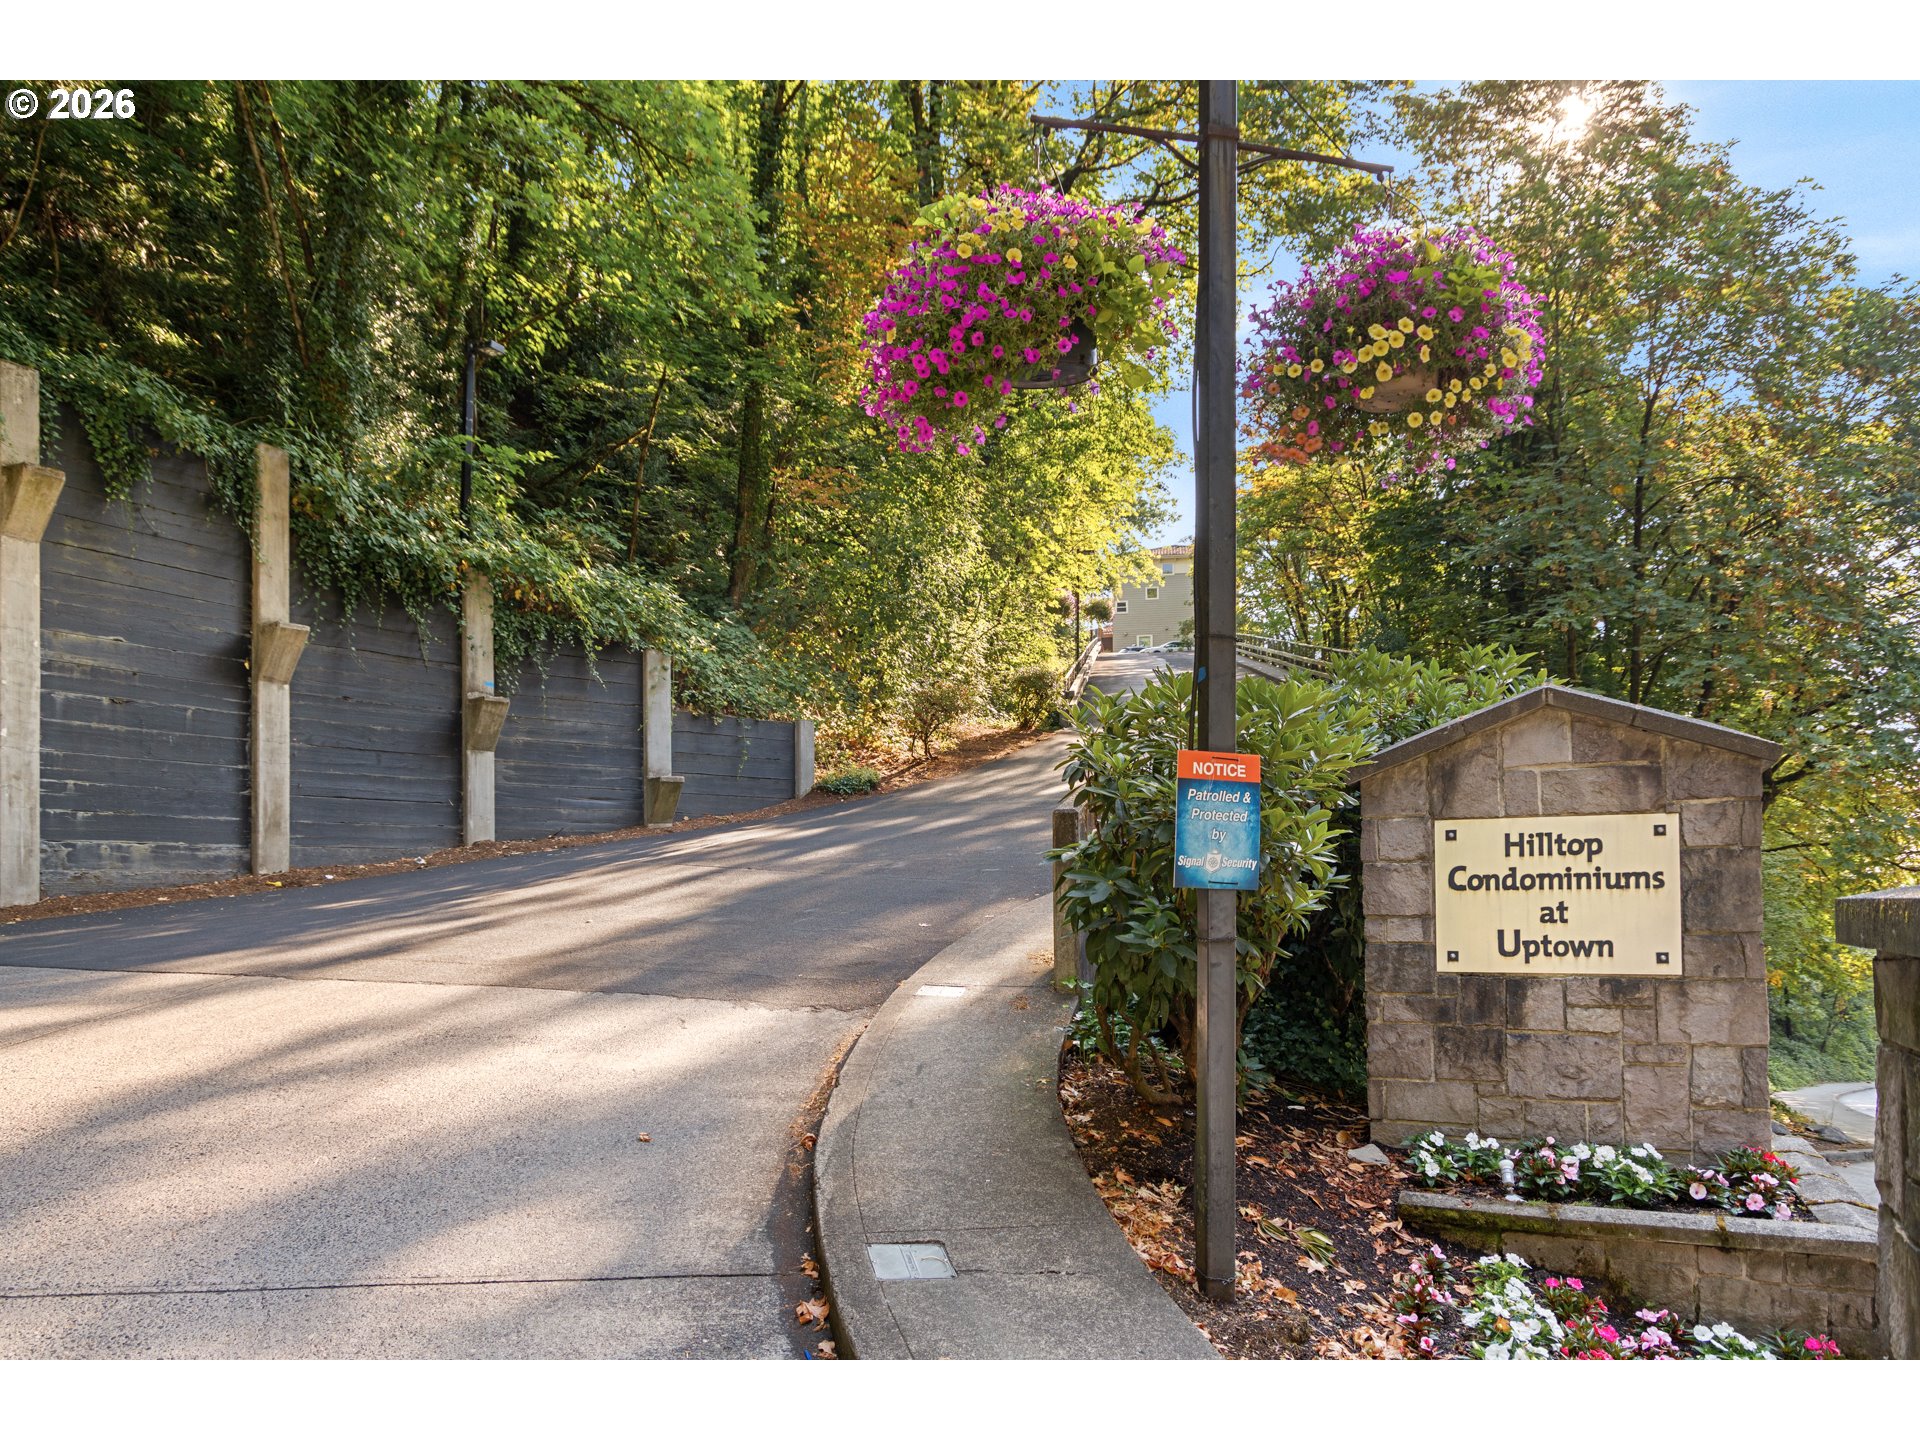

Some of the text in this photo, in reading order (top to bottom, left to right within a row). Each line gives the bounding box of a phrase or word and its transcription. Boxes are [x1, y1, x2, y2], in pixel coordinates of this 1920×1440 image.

[1192, 761, 1247, 777] NOTICE
[1187, 788, 1252, 803] Patrolled &
[1191, 808, 1248, 822] Protected
[1211, 828, 1227, 843] by
[1504, 832, 1603, 862] Hilltop
[1177, 855, 1258, 871] Signal Security
[1448, 865, 1665, 891] Condominiums
[1539, 901, 1569, 924] at
[1497, 929, 1614, 964] Uptown
